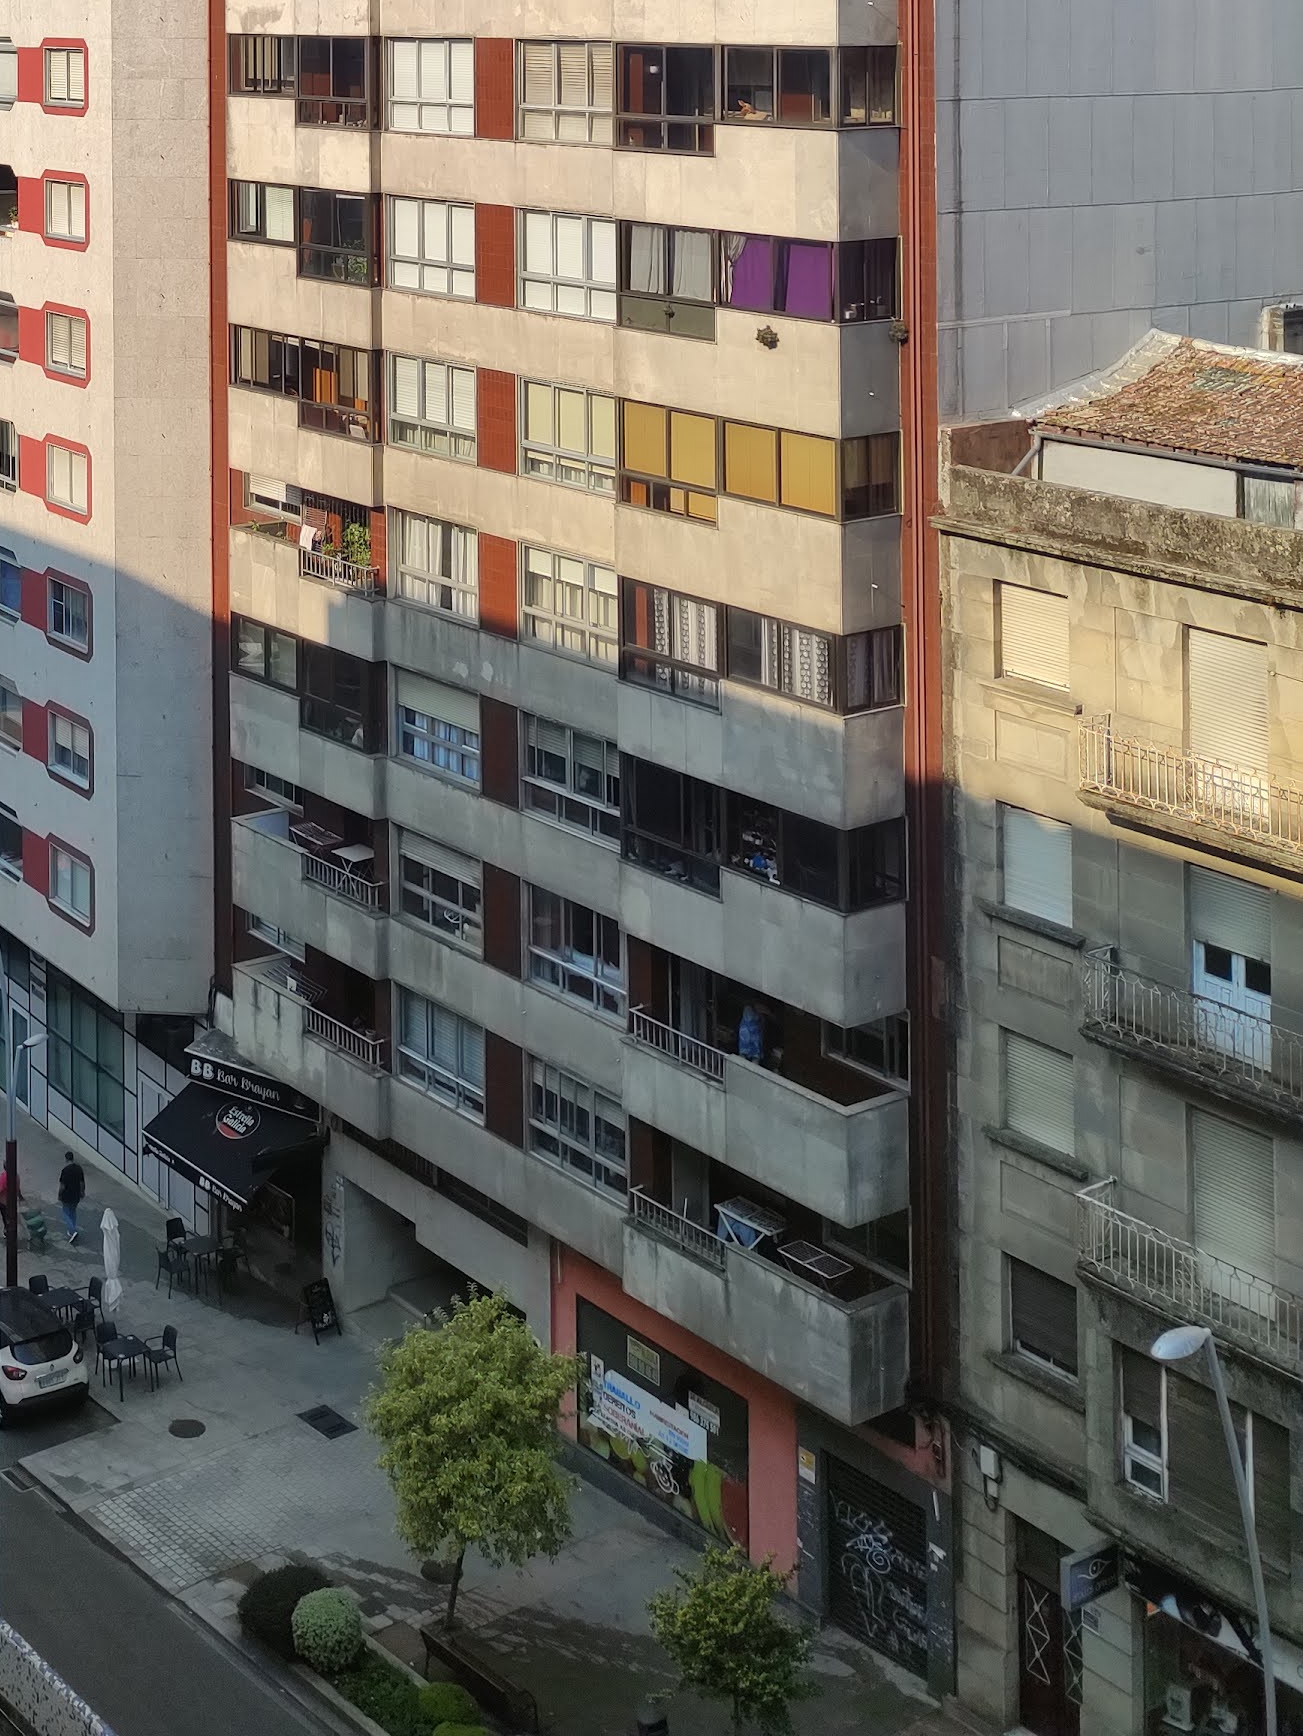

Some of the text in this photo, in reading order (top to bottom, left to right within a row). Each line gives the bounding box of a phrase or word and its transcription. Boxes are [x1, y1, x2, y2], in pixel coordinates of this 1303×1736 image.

[190, 1058, 281, 1102] BB Bar Brayan
[223, 1114, 247, 1134] Galicia
[228, 1105, 255, 1127] Estrella
